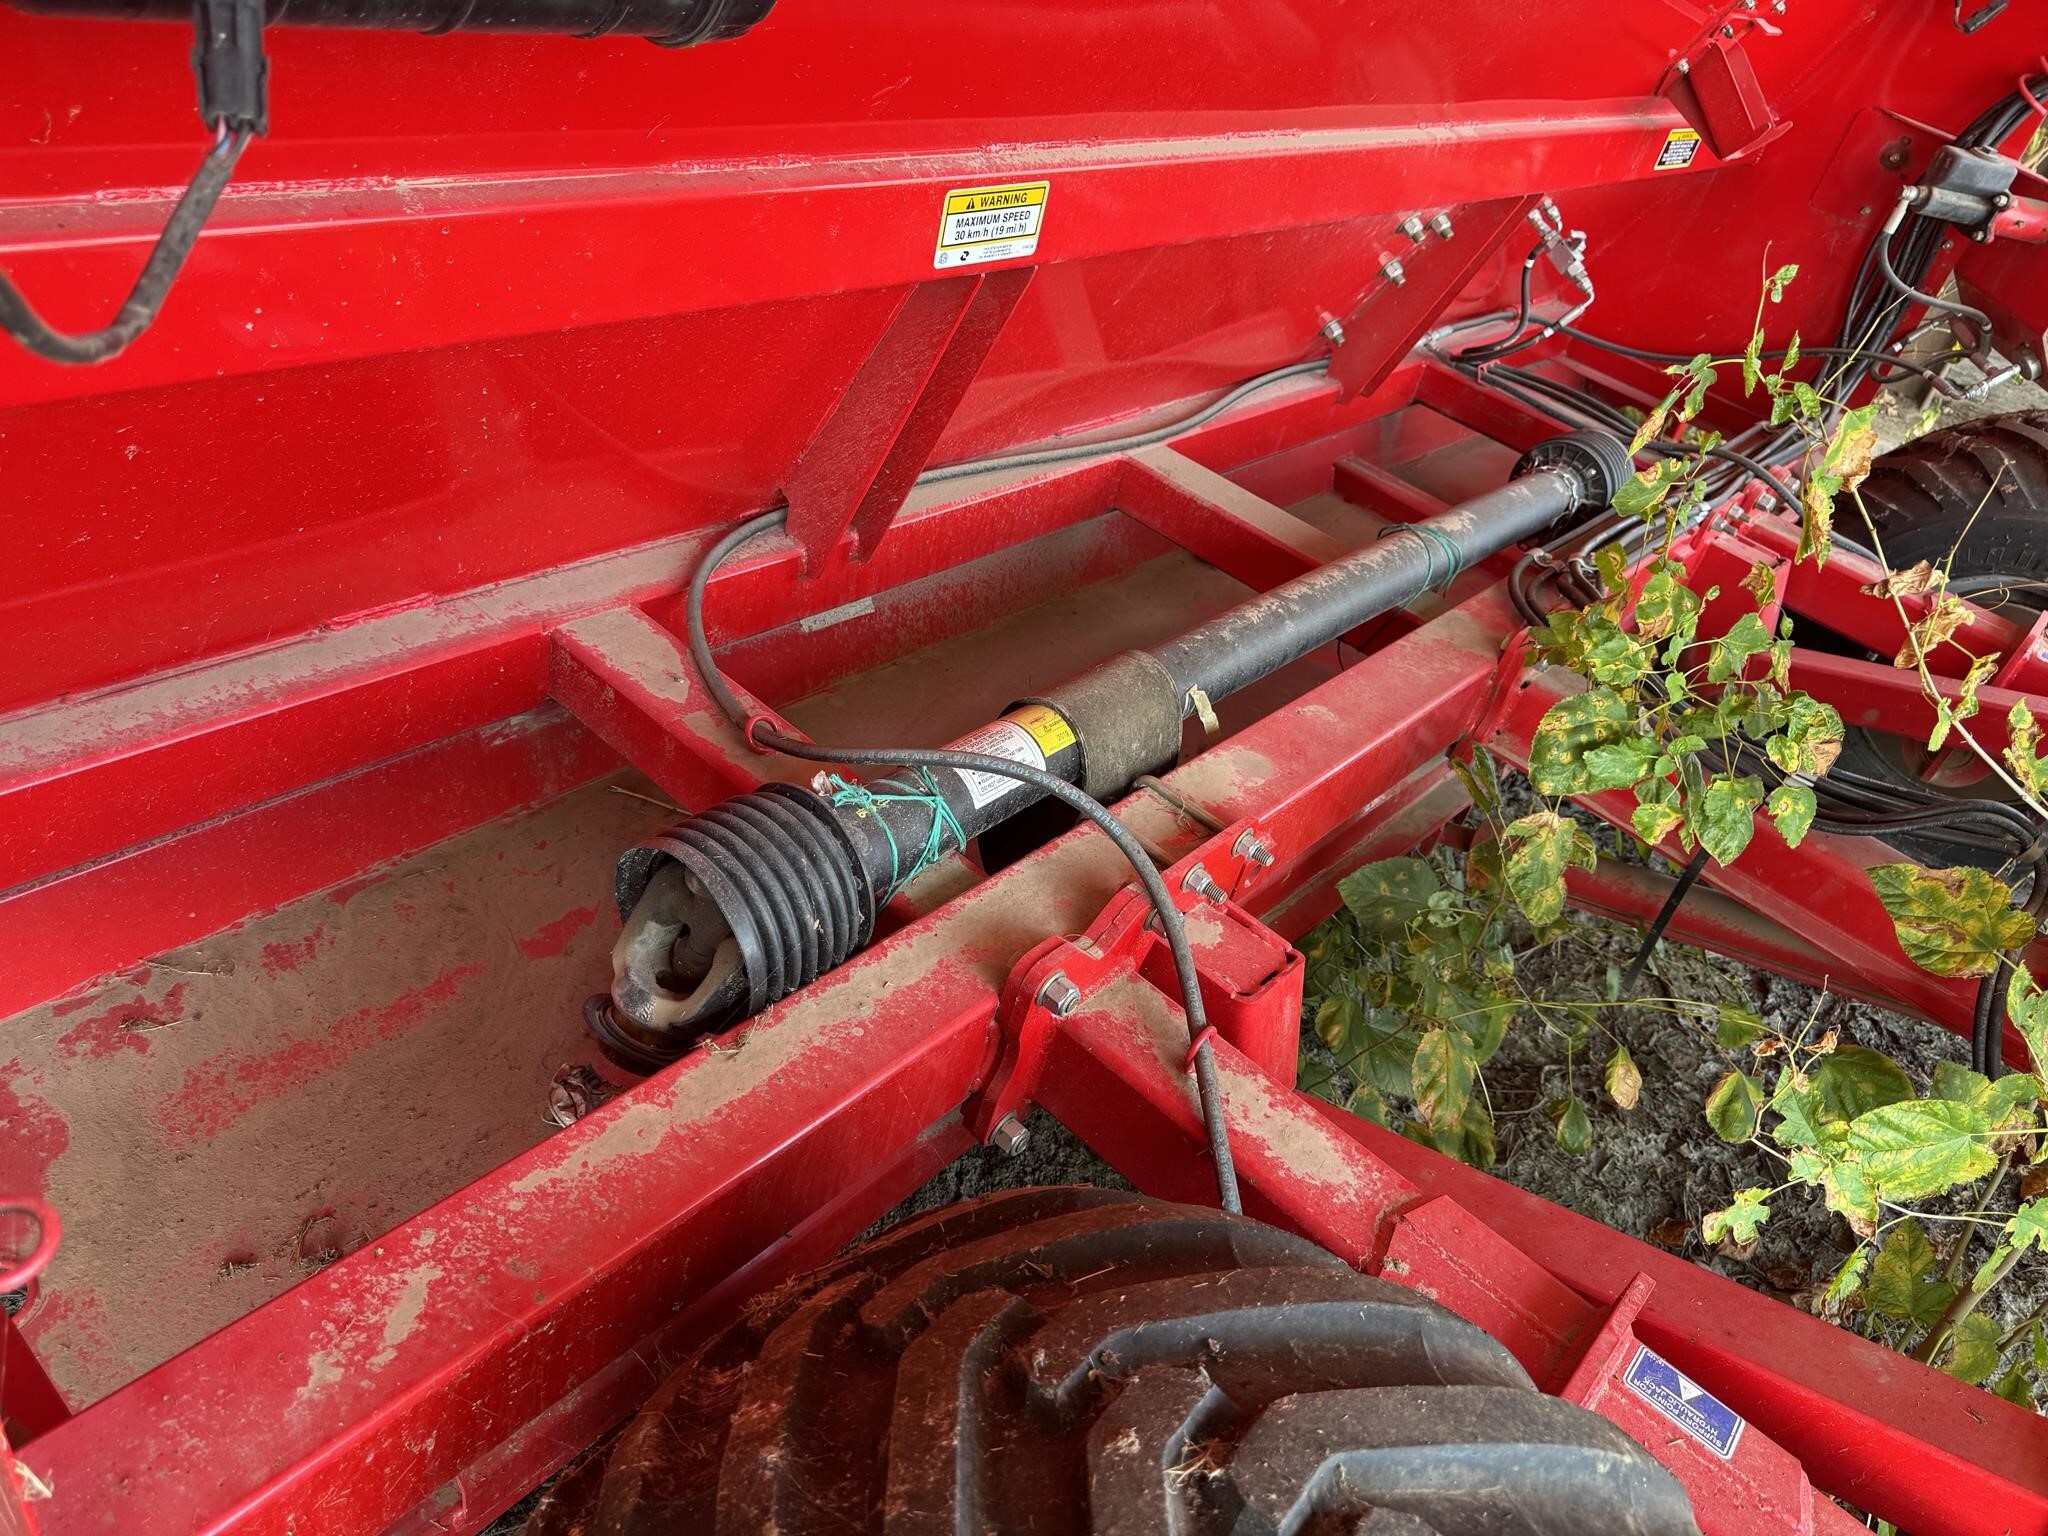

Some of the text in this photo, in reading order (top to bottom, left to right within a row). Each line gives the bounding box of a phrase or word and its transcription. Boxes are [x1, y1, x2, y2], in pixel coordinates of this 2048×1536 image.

[980, 193, 1028, 208] WARNING
[955, 210, 1031, 228] MAXIMUM SPEED
[954, 230, 965, 241] 30
[990, 225, 1005, 238] (19
[1008, 763, 1031, 777] 100
[1031, 771, 1057, 788] SAE
[1631, 1377, 1723, 1448] SUPPORT POINT FOR
[1641, 1376, 1718, 1436] HYDRAULIC JACK
